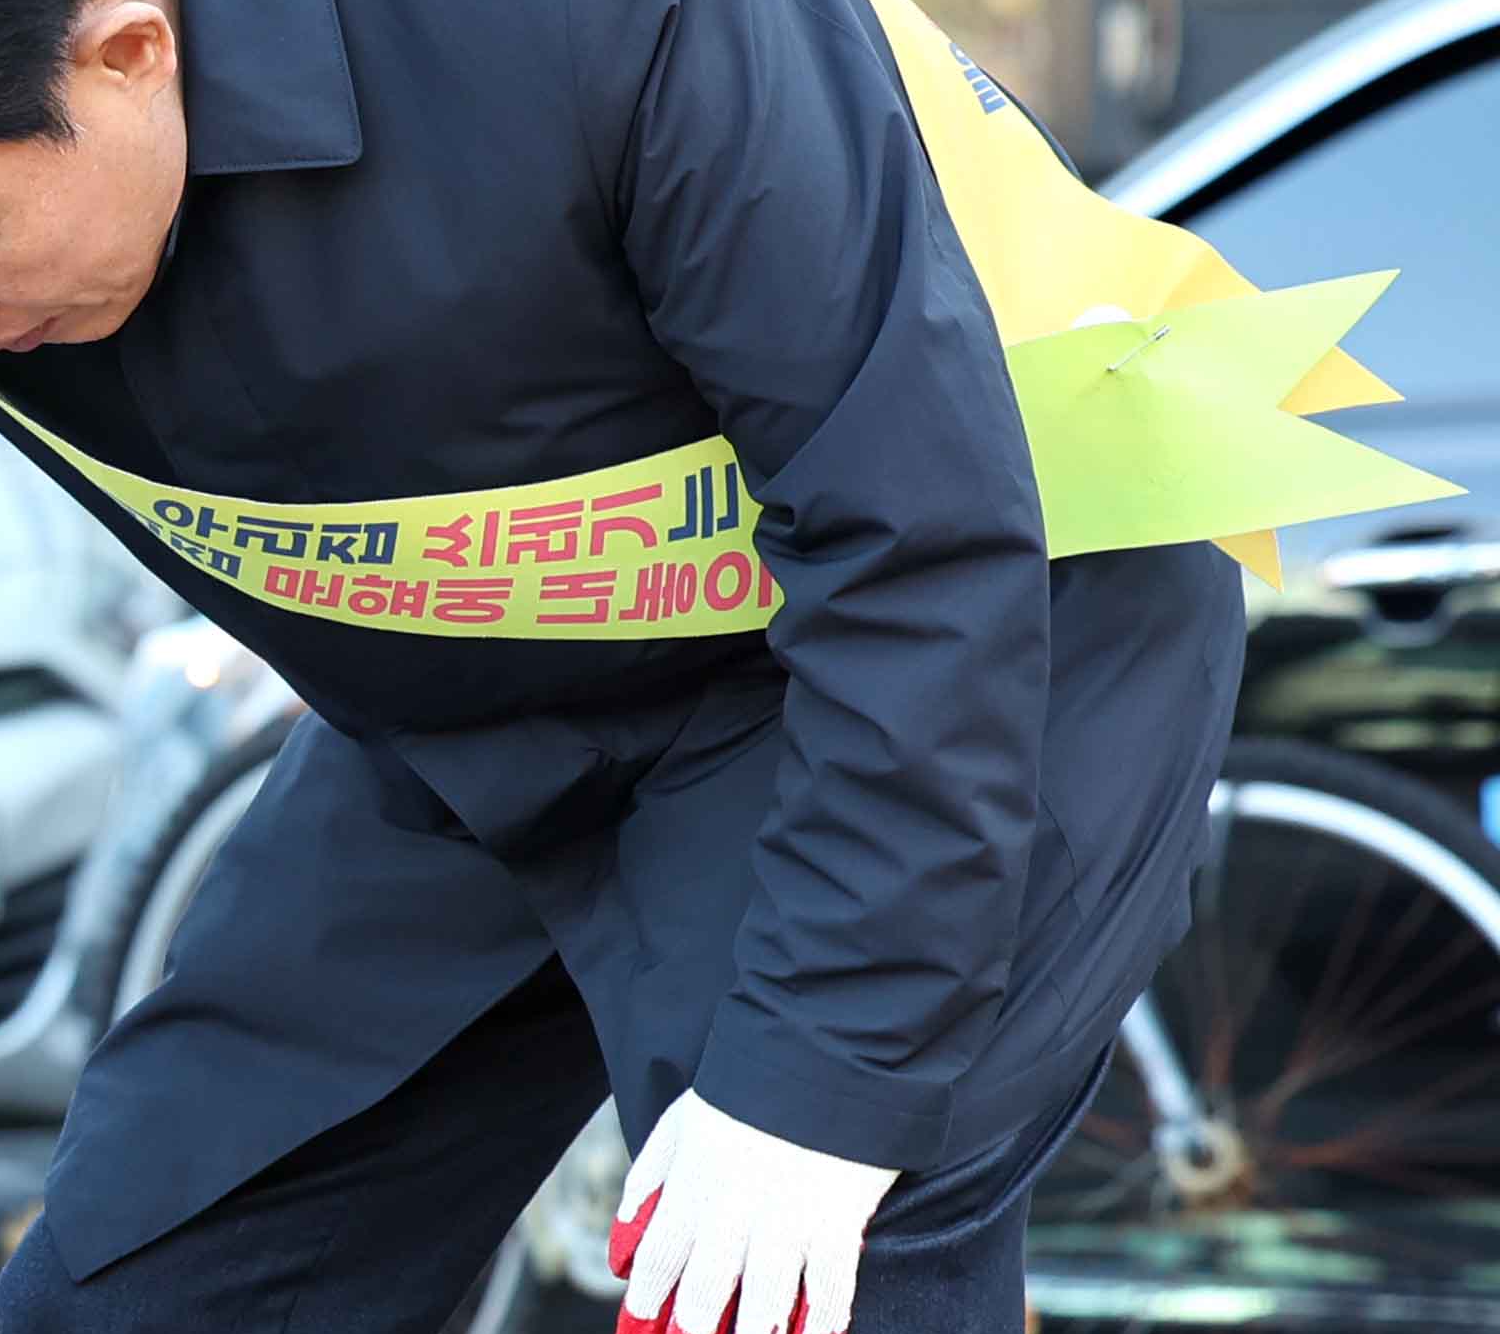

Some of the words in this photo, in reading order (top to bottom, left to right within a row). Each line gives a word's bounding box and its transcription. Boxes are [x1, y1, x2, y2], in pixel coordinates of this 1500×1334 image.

[152, 498, 400, 566] 우리집
[421, 461, 741, 568] 쓰레기는
[263, 564, 514, 625] 문앞에
